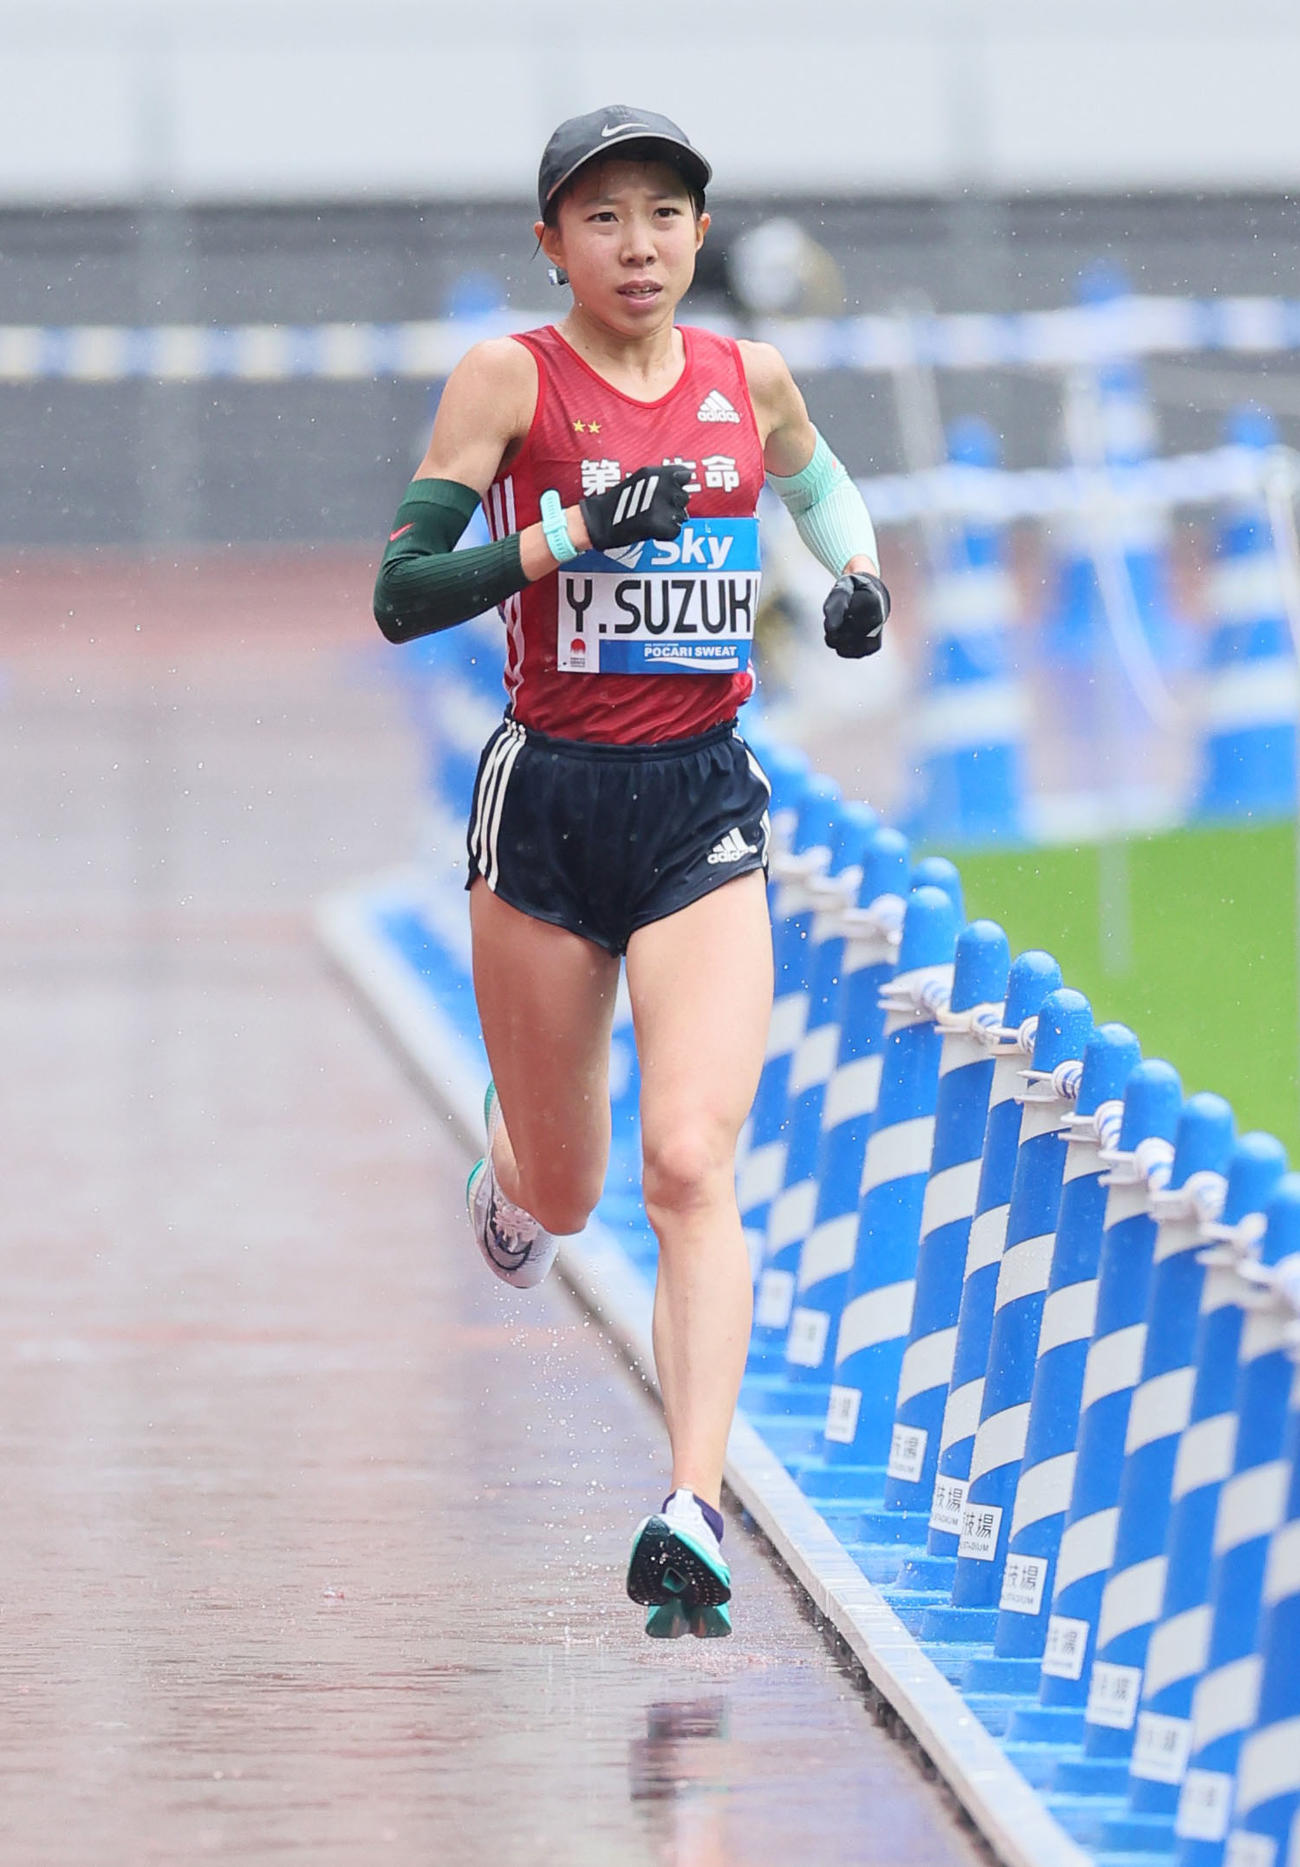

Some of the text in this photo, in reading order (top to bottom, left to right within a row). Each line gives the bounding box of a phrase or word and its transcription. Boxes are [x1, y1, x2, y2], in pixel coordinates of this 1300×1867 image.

[651, 527, 734, 569] Sky
[644, 646, 737, 657] POCARI SWEAT
